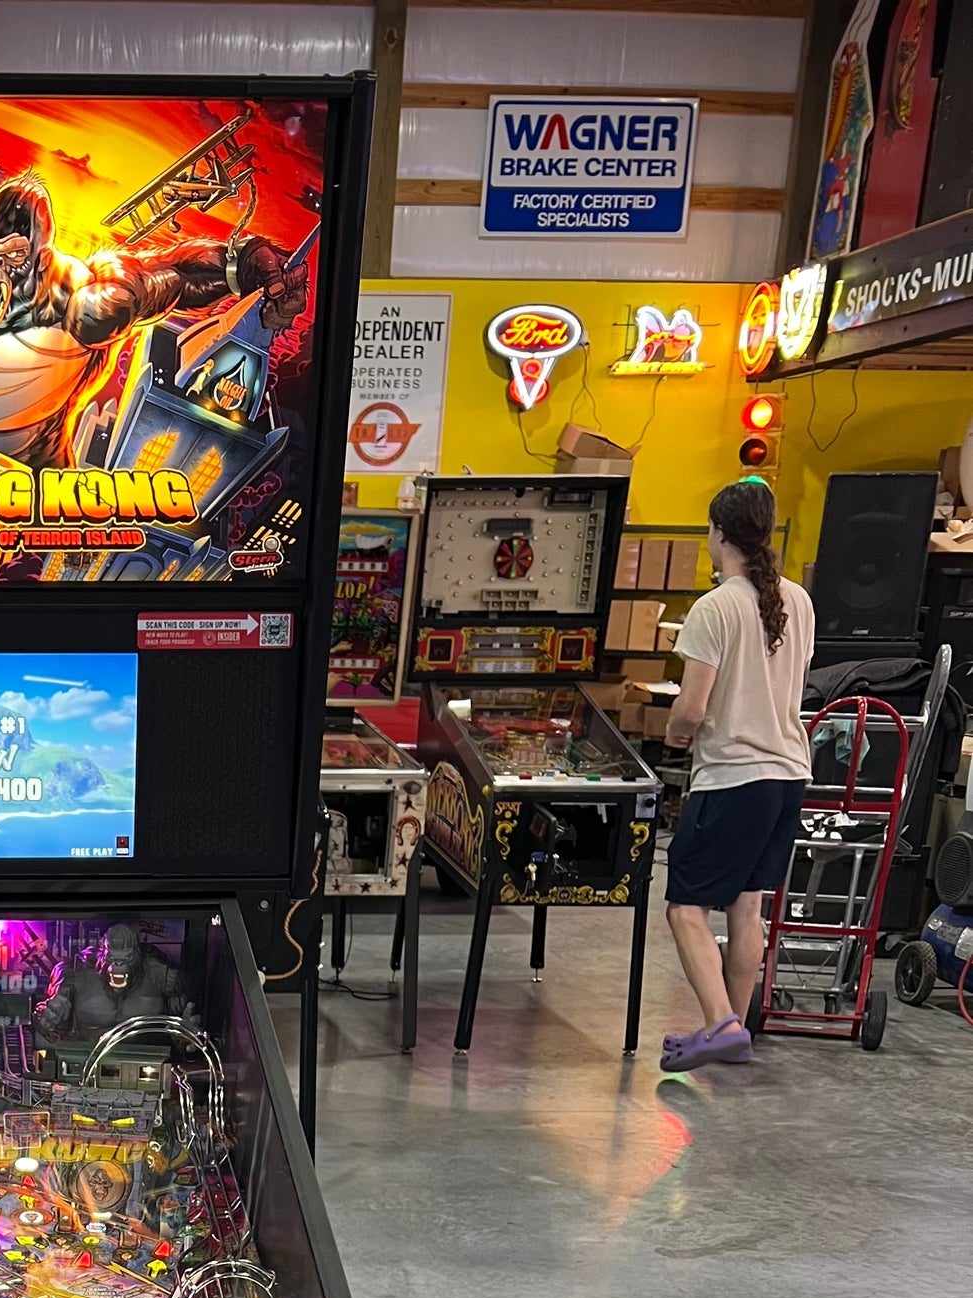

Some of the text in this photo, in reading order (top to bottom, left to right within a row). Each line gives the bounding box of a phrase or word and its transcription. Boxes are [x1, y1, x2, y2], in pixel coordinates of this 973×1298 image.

[504, 113, 679, 151] WAGNER
[500, 157, 676, 177] BRAKE CENTER
[513, 194, 656, 209] FACTORY CERTIFIED
[537, 212, 629, 227] SPECIALISTS
[380, 306, 401, 318] AN
[502, 314, 569, 346] Ford
[352, 345, 425, 359] DEALER
[352, 367, 423, 377] OPERATED
[220, 395, 234, 410] OIL
[40, 469, 199, 525] KONG
[0, 530, 21, 547] OF
[23, 530, 84, 547] TERROR
[86, 530, 144, 547] ISLAND
[235, 554, 277, 566] Stern
[145, 621, 241, 629] SCAN THIS CODE SIGN UP NOW!
[217, 632, 240, 641] INSIDER
[0, 715, 26, 735] #1
[70, 847, 113, 856] FREE PLAY
